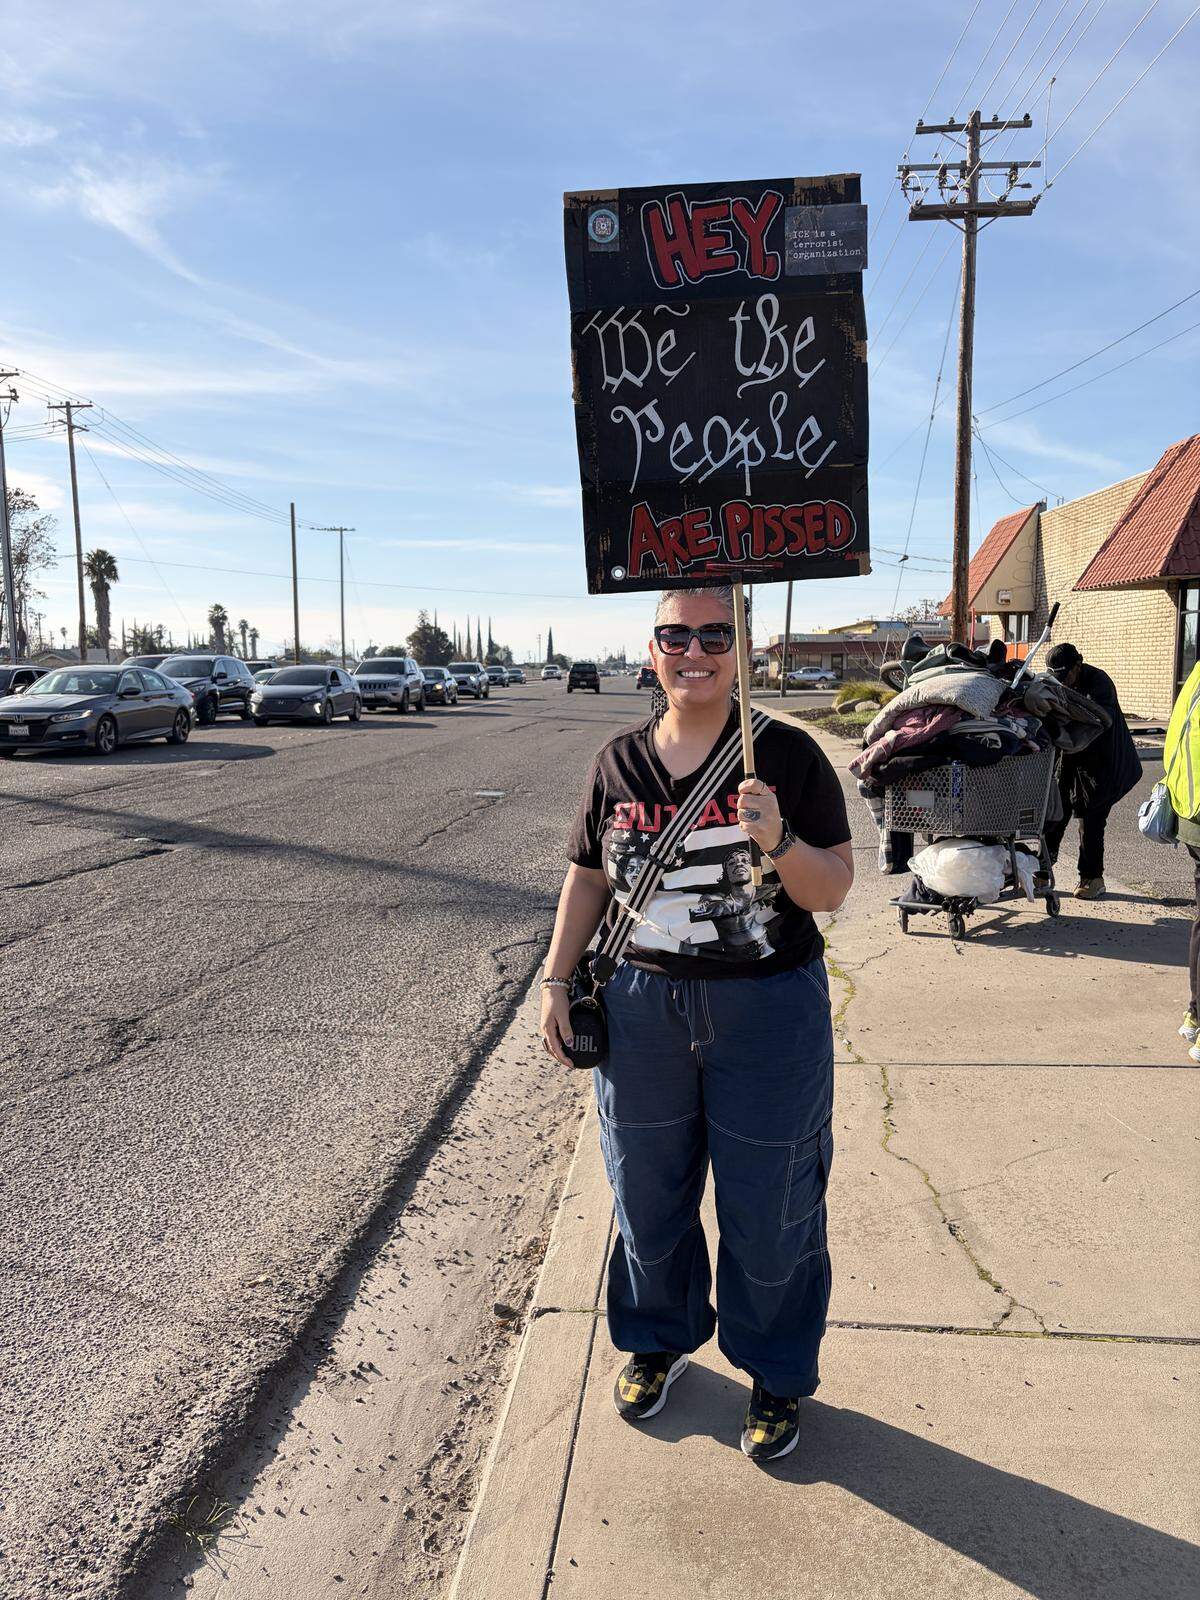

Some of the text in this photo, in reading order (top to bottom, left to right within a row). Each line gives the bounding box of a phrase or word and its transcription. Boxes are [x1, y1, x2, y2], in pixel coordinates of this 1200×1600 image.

[793, 230, 810, 239] ICE
[814, 229, 826, 238] is
[793, 239, 844, 248] terrorist
[792, 248, 861, 260] organization
[581, 293, 827, 399] We the
[610, 391, 837, 496] People
[628, 499, 857, 578] ARE PISSED
[572, 1035, 598, 1053] JBL
